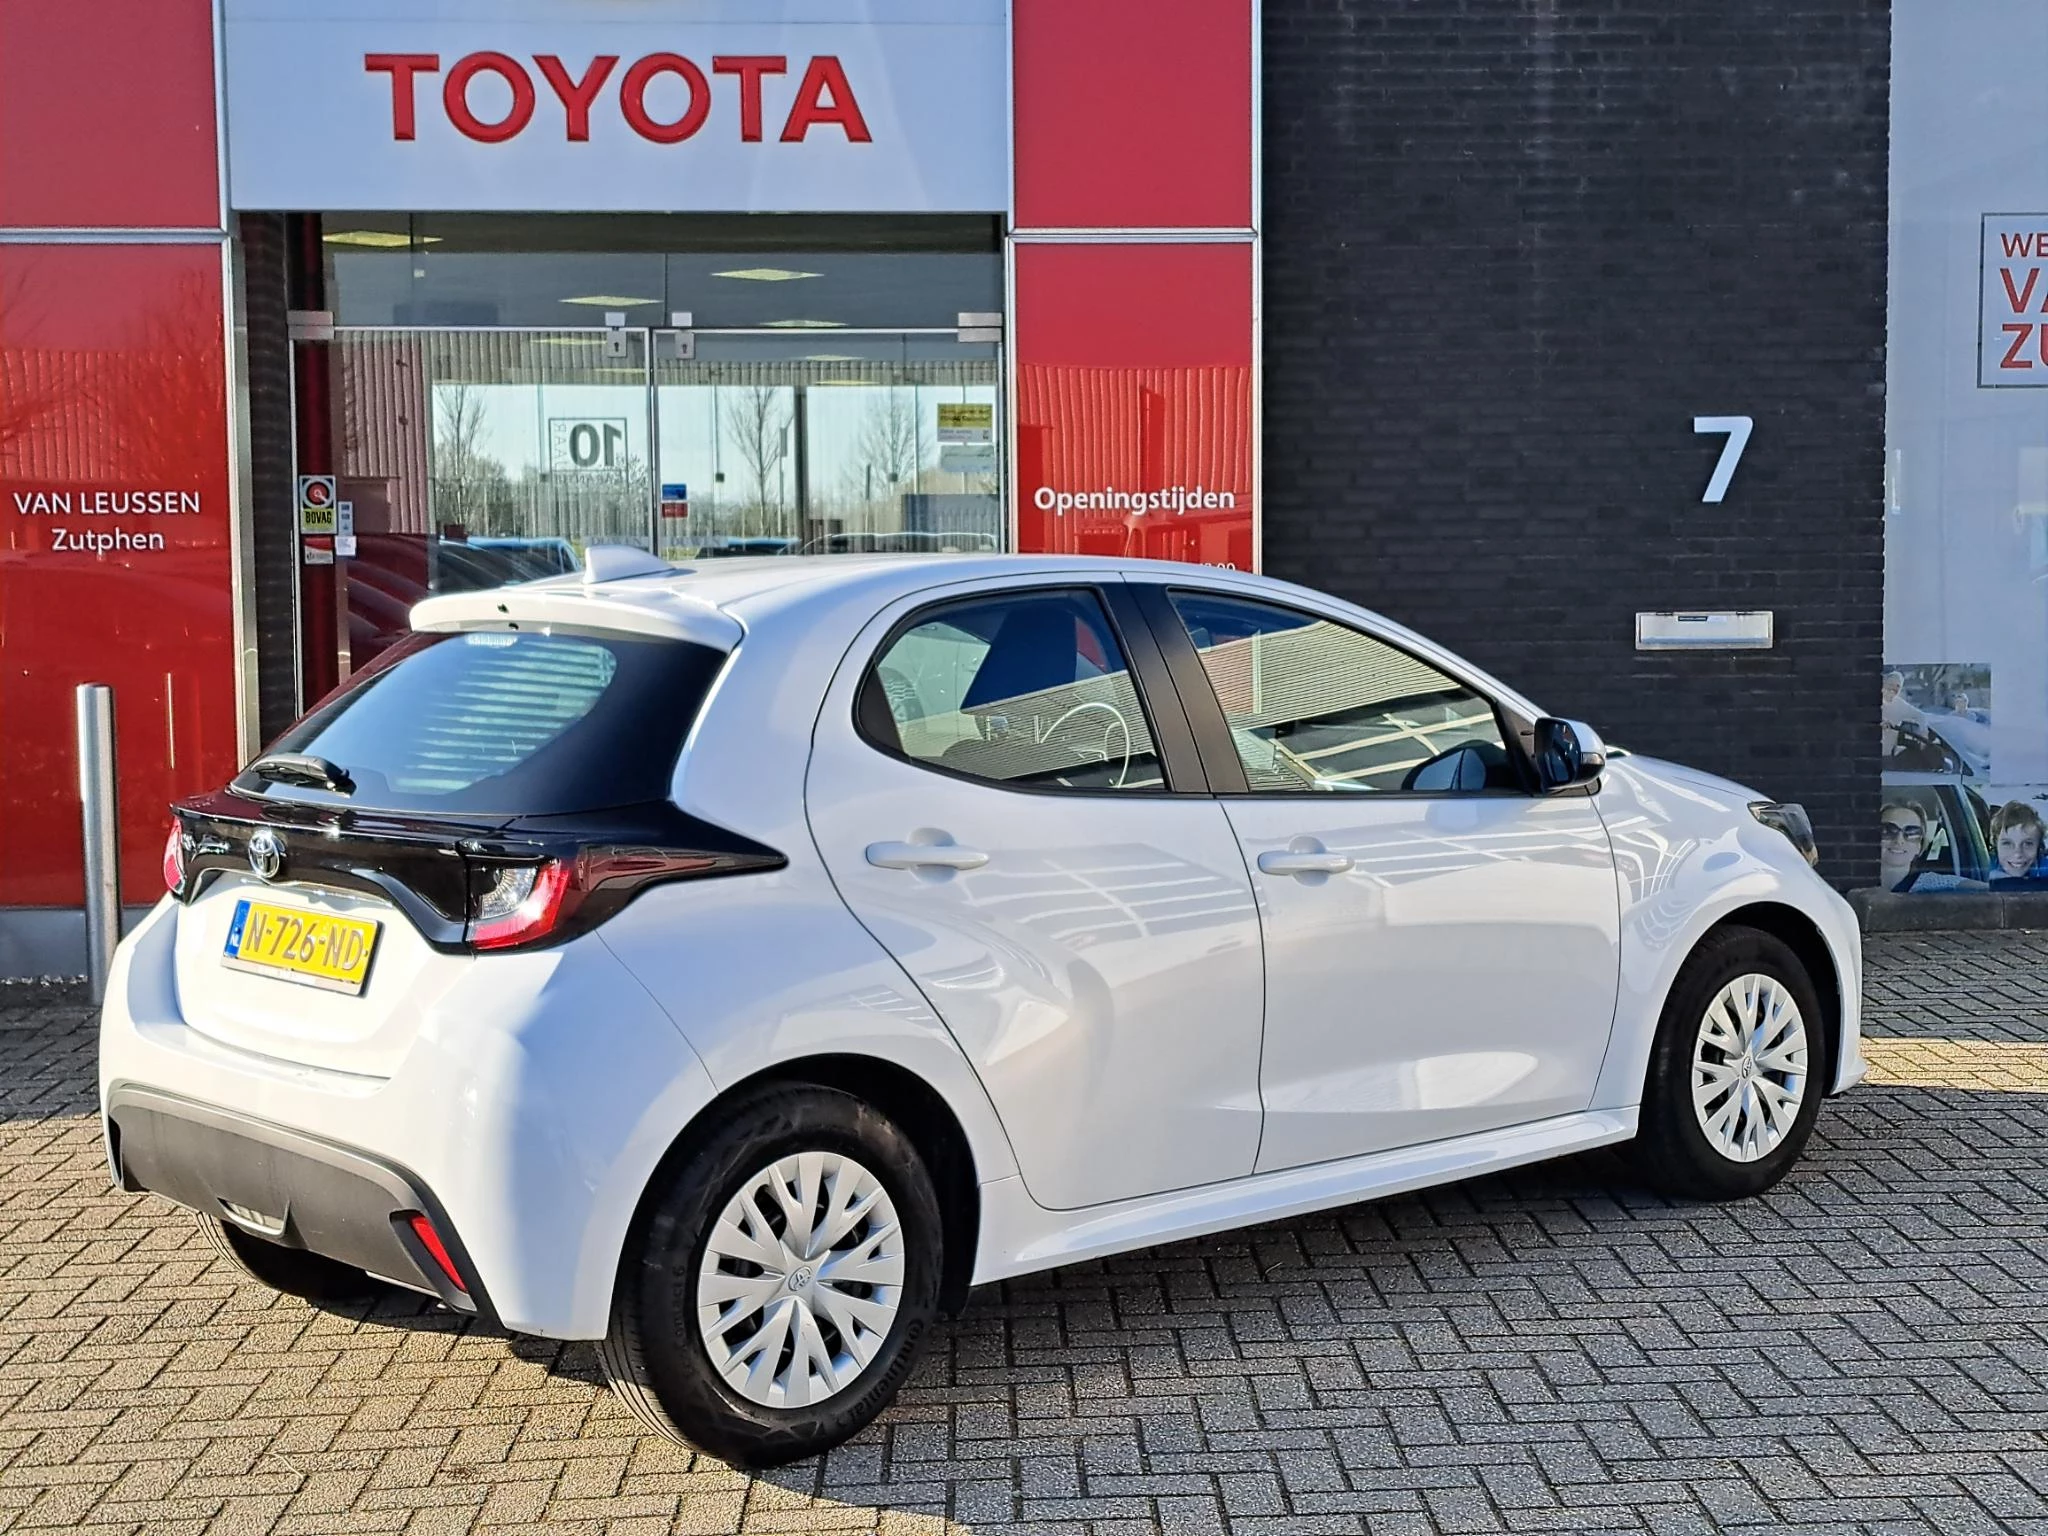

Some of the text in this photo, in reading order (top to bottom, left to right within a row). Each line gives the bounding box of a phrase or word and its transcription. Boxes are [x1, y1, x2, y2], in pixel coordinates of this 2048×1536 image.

[364, 51, 873, 144] TOYOTA
[2000, 268, 2048, 313] V
[2000, 324, 2048, 368] Z
[1694, 416, 1753, 502] 7
[14, 491, 200, 513] VAN LEUSSEN
[305, 511, 332, 524] BOVAG
[1034, 487, 1235, 516] Openingstijden
[52, 527, 164, 556] Zutphen
[246, 911, 364, 971] N-726-ND
